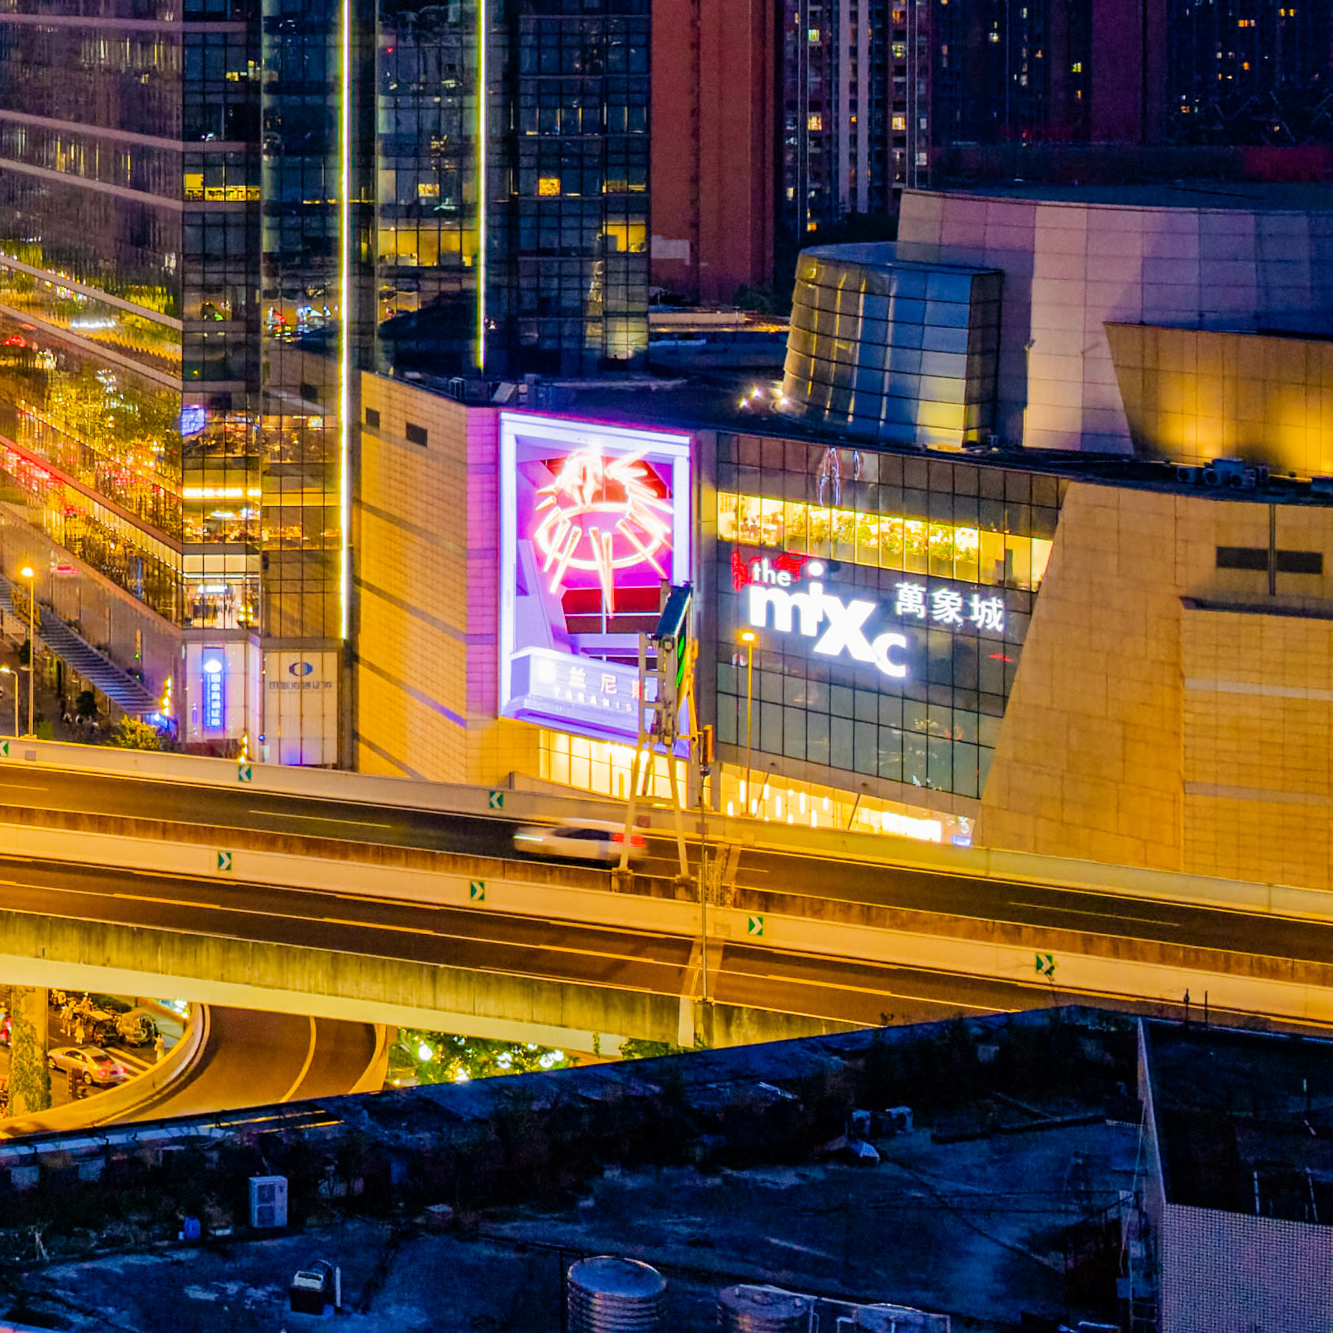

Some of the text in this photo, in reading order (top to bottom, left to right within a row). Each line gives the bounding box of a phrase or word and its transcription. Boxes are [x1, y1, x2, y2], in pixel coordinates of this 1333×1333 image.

[753, 558, 792, 587] the
[894, 582, 1005, 633] 萬象城
[537, 659, 649, 702] 兰尼斯
[553, 686, 633, 713] TARANIS
